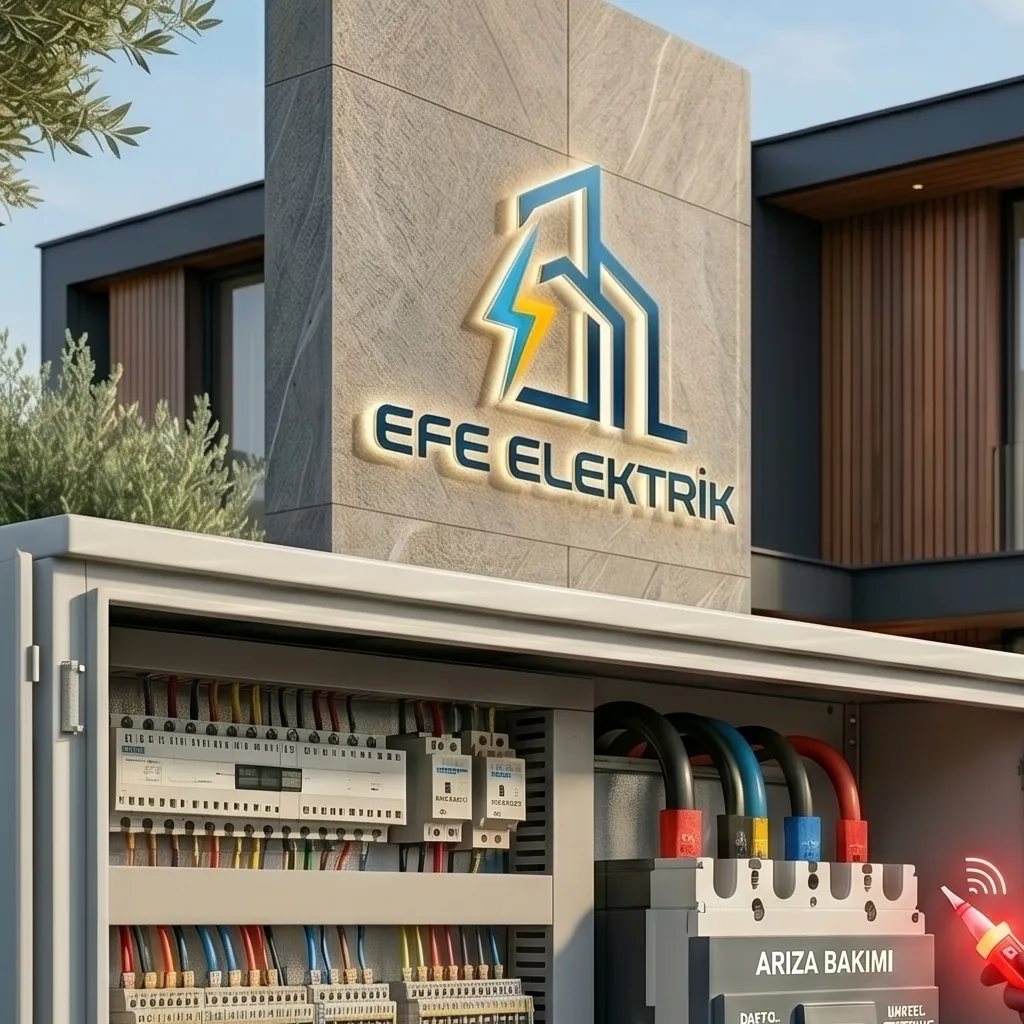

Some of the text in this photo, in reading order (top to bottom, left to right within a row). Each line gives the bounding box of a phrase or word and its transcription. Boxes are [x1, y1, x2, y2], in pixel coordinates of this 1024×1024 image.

[375, 403, 736, 525] EFE ELEKTRİK
[755, 949, 894, 975] ARIZA BAKIMI
